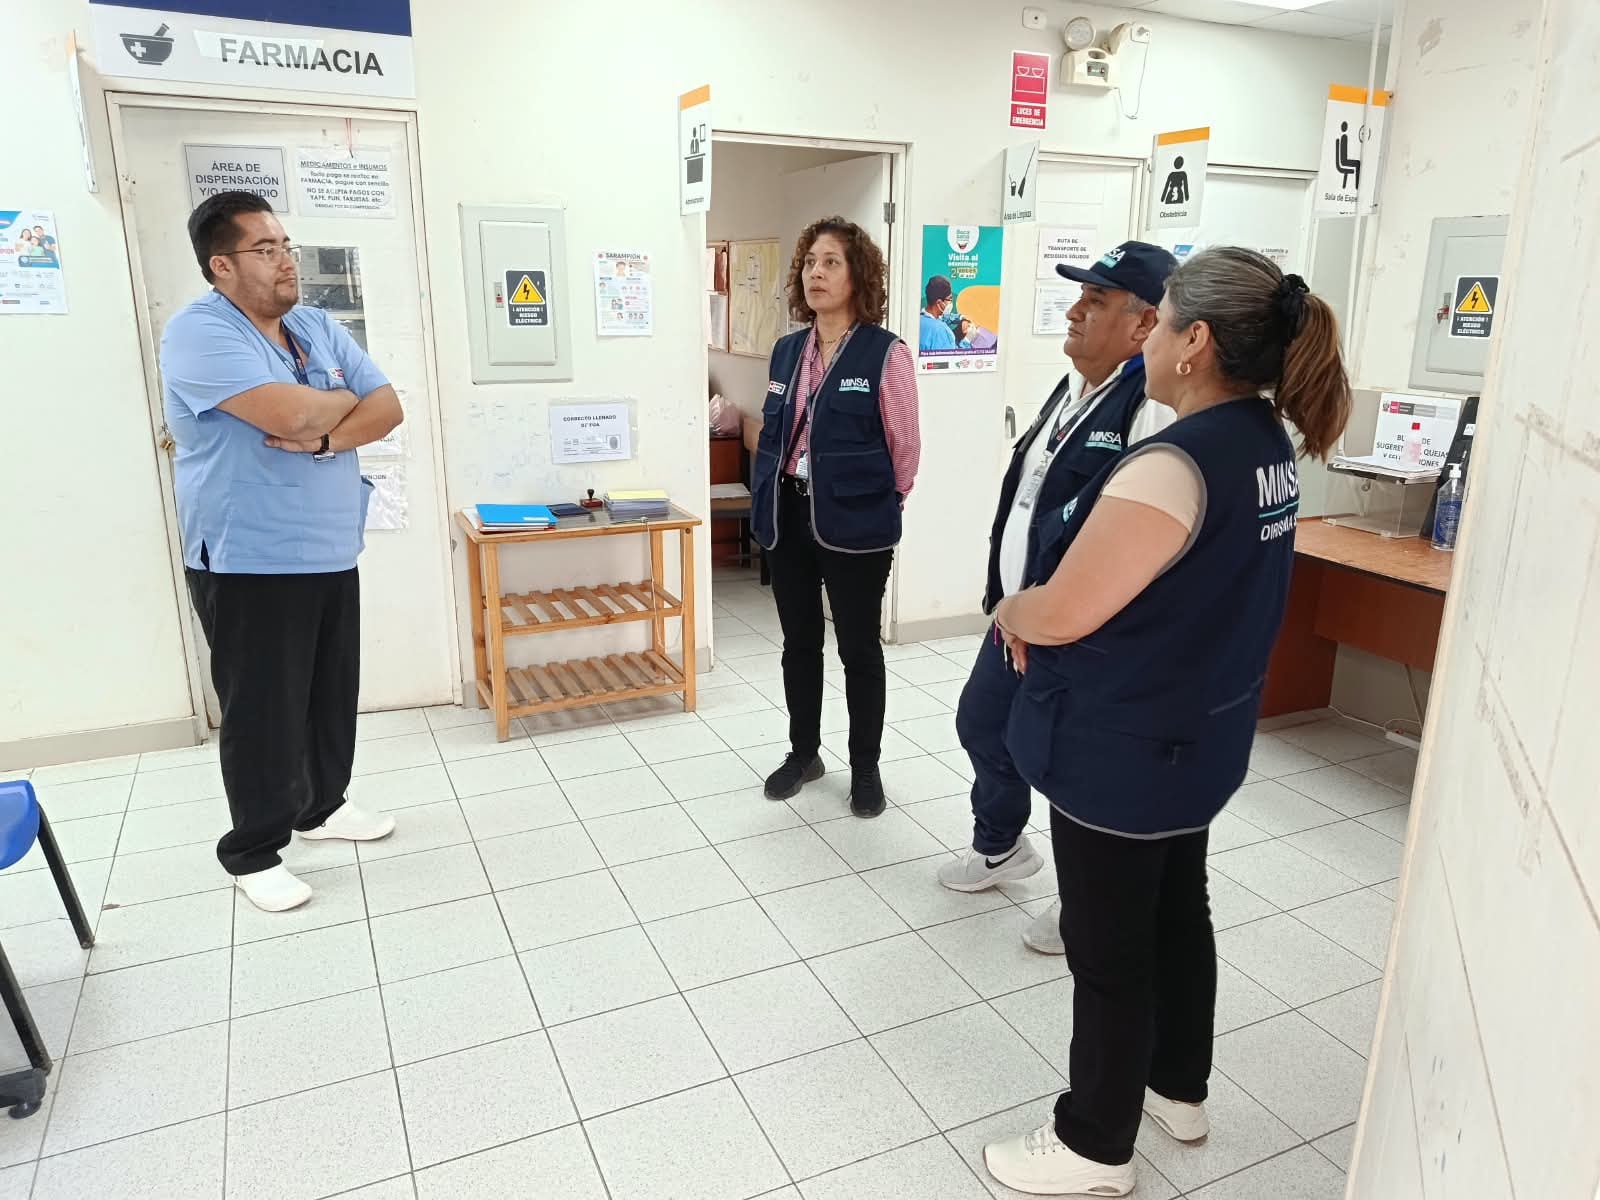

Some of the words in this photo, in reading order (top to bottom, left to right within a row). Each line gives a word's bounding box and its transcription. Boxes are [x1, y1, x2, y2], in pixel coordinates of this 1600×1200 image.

[219, 37, 384, 77] FARMACIA
[1016, 106, 1032, 116] LUCES
[1033, 108, 1041, 117] DE
[211, 160, 243, 172] ÁREA
[246, 162, 261, 173] DE
[195, 174, 279, 186] DISPENSACIÓN
[1324, 192, 1336, 201] Sala
[1336, 194, 1344, 202] de
[840, 377, 870, 388] MINSA
[1088, 431, 1122, 445] MINSA
[1421, 437, 1431, 446] DE
